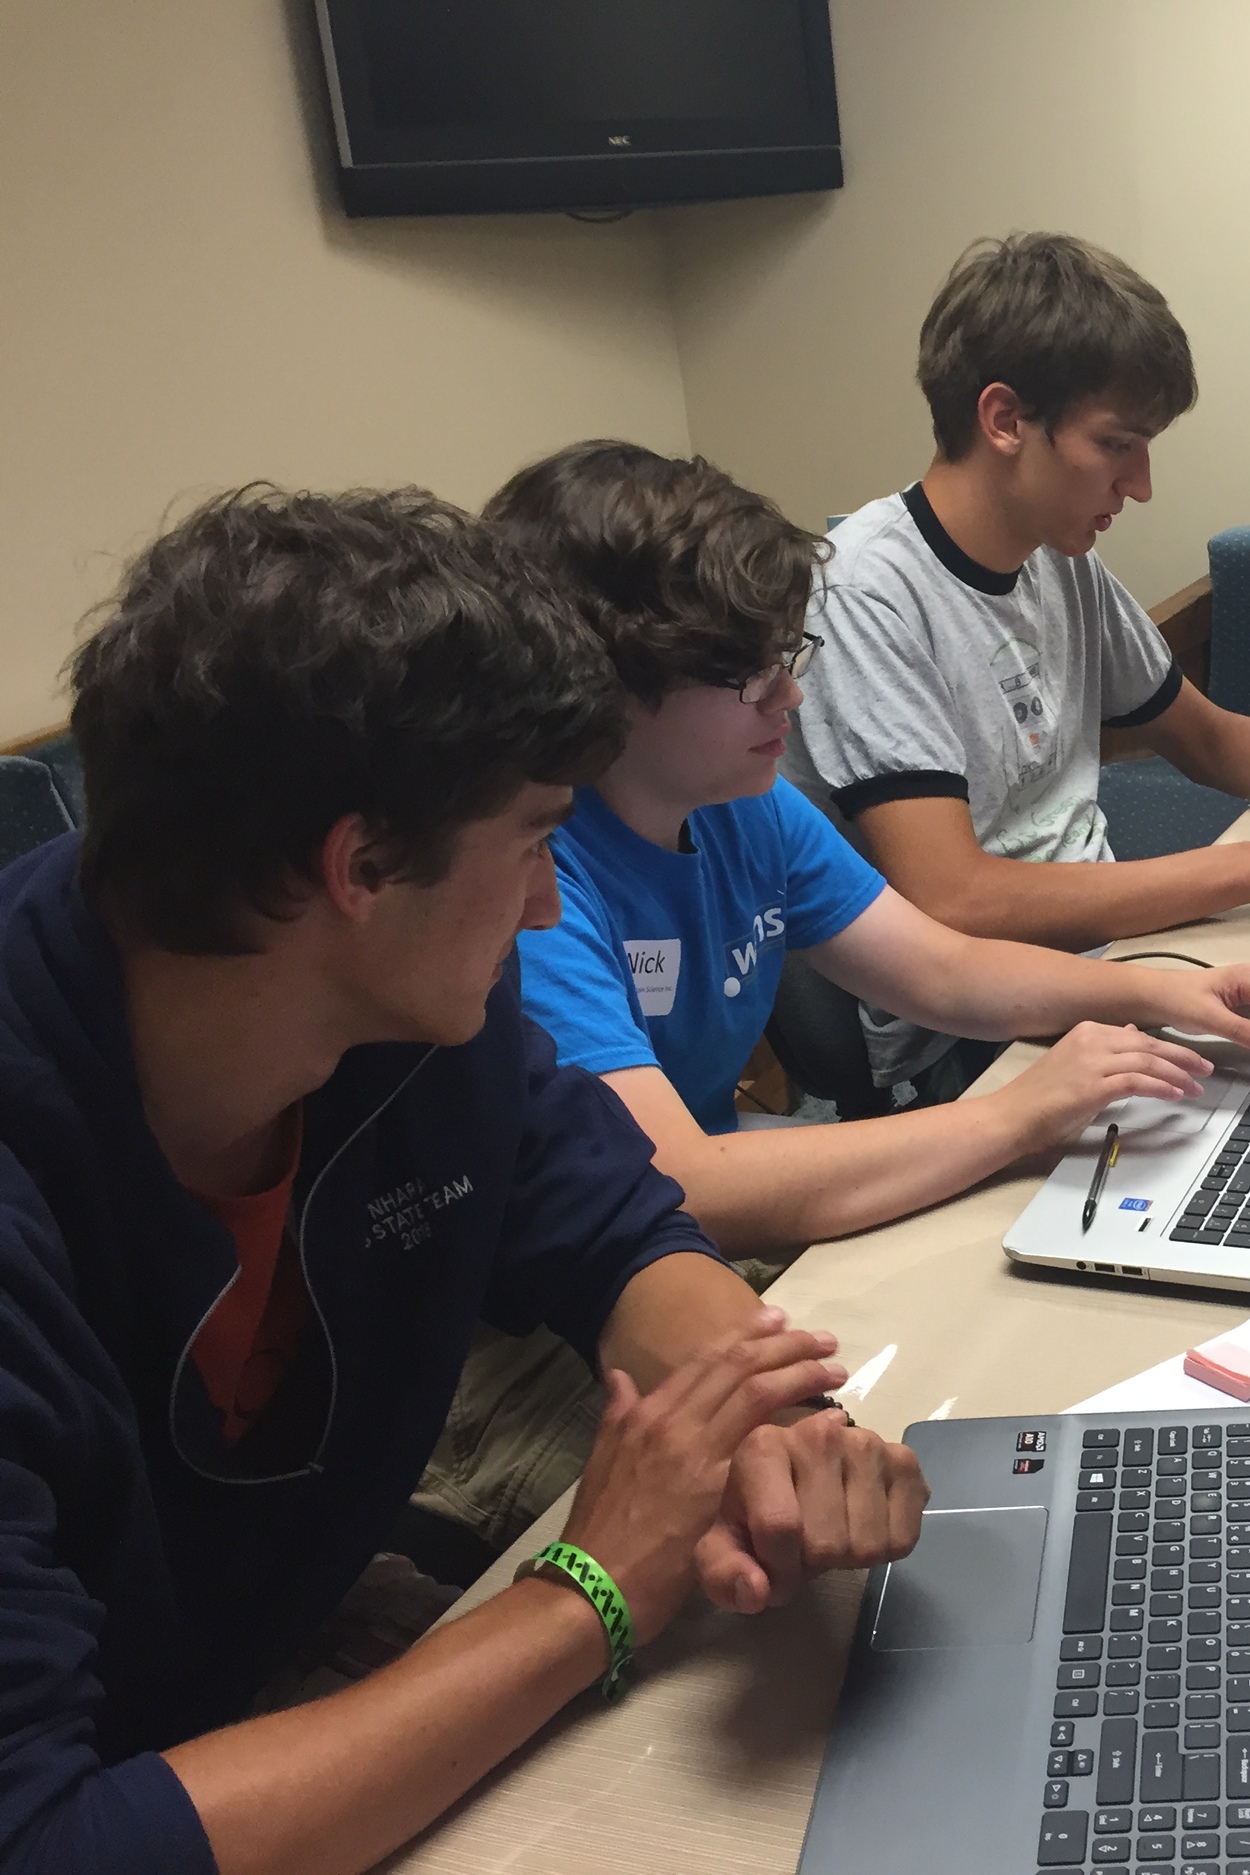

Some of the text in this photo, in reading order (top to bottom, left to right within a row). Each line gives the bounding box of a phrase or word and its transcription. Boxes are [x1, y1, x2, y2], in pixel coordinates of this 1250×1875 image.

[608, 135, 631, 146] NEC
[372, 1175, 474, 1240] STATE TEAM
